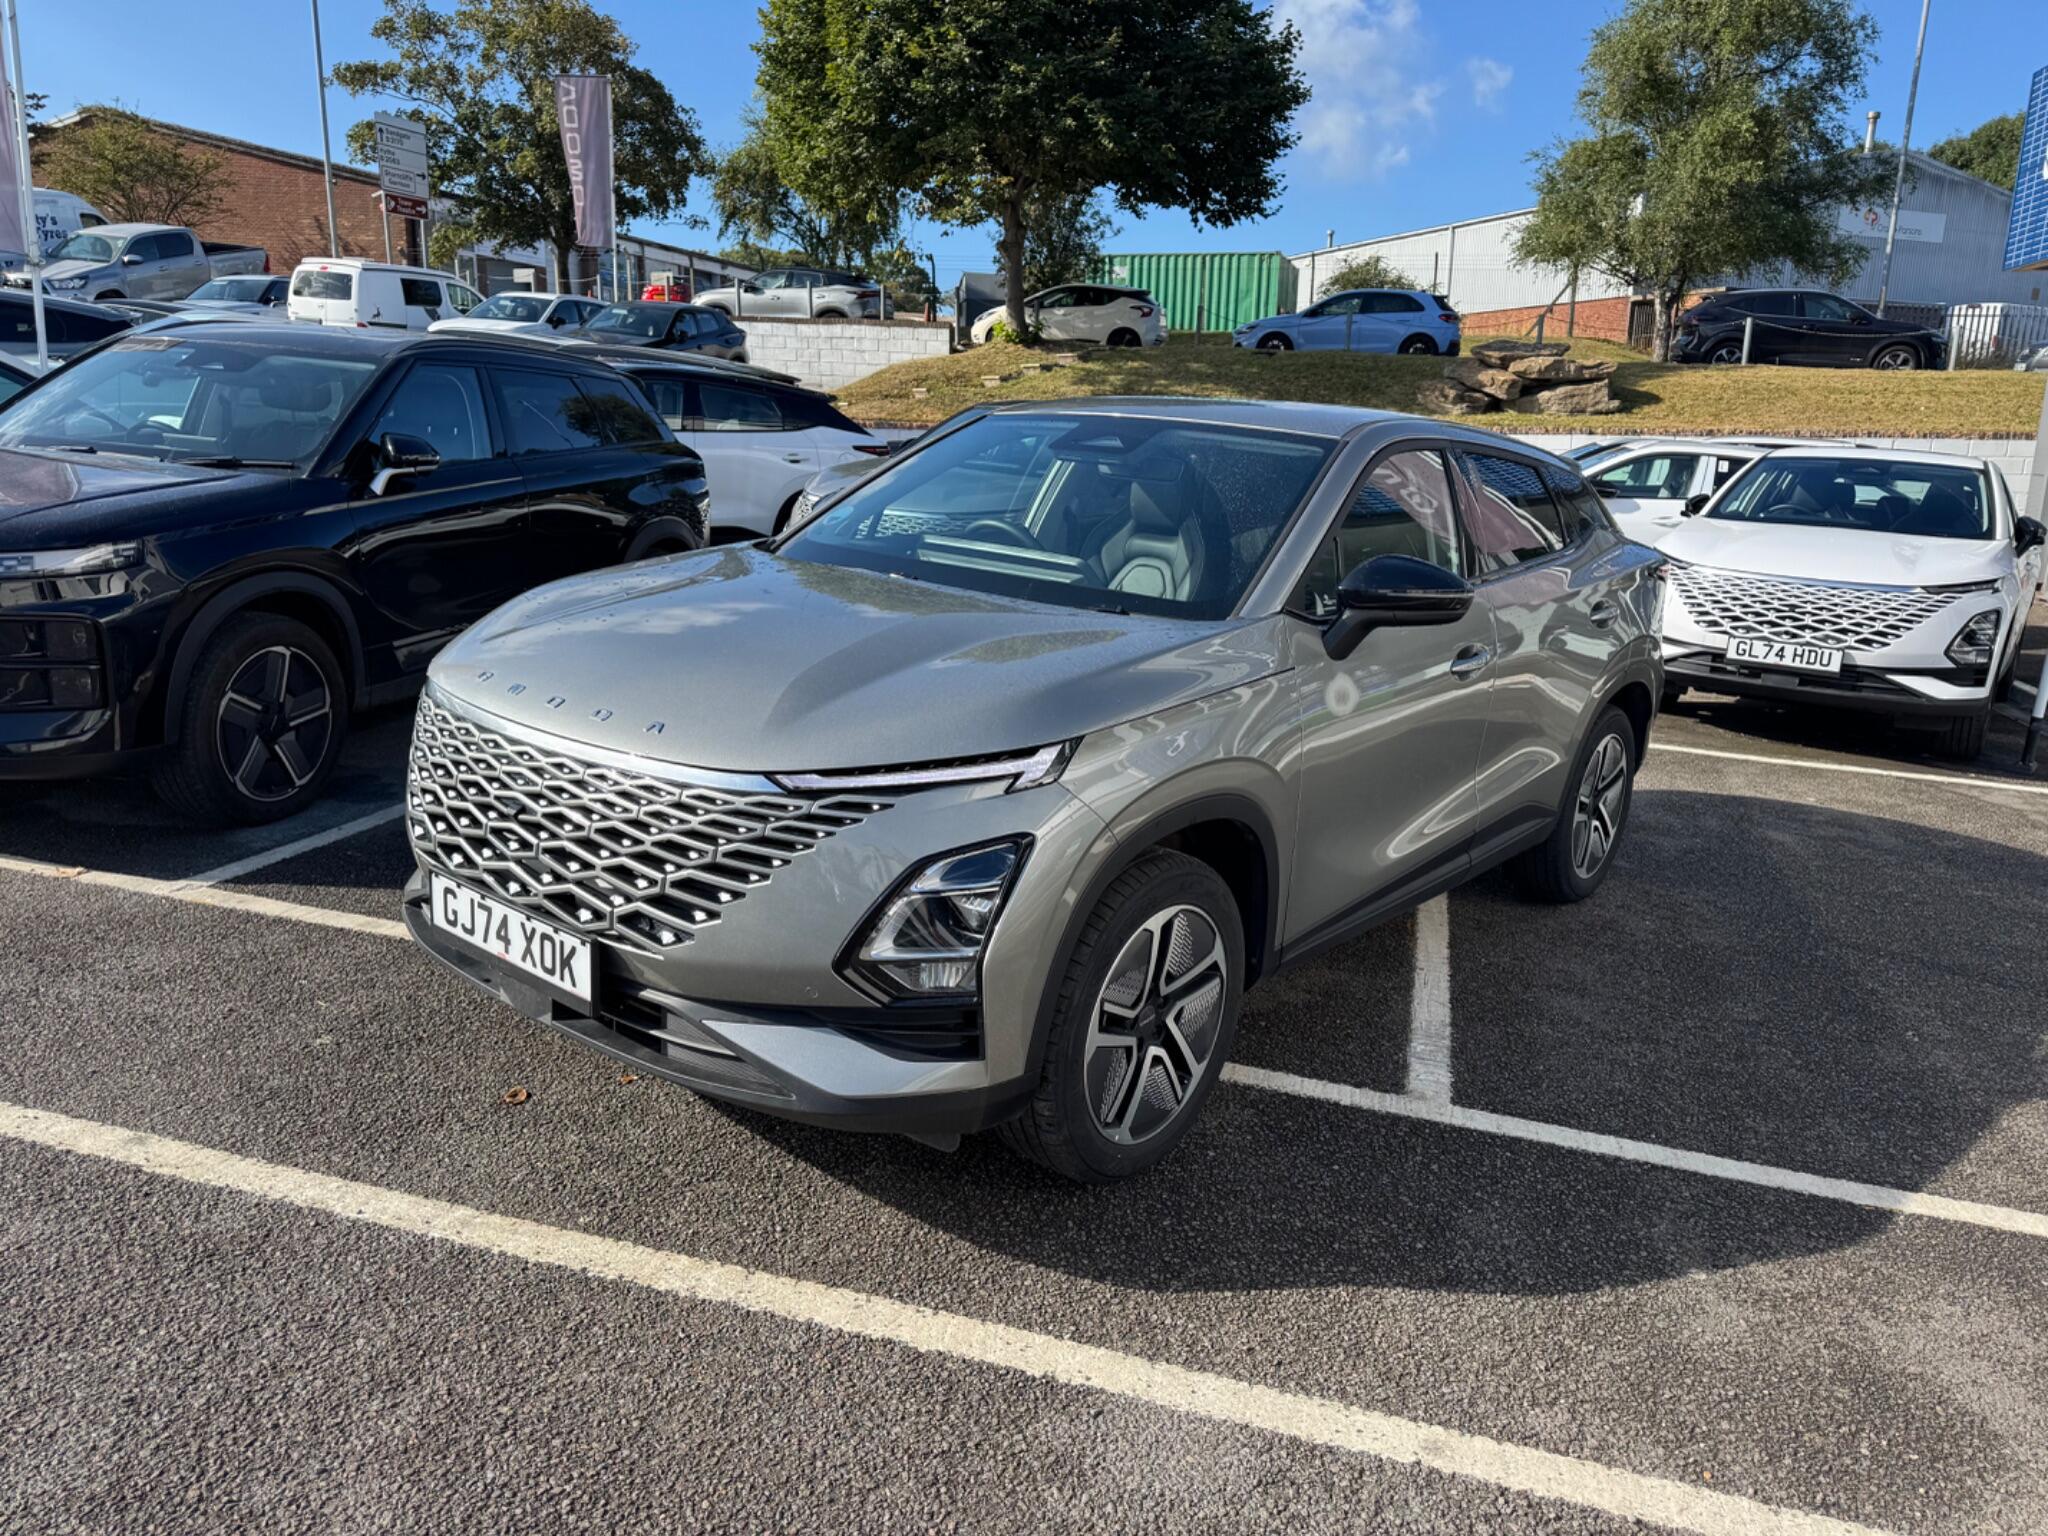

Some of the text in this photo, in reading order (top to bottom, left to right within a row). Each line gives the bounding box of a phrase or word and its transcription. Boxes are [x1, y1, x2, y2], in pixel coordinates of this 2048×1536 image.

[1735, 640, 1832, 668] GL74 HDU
[478, 671, 665, 735] OMODA
[443, 886, 577, 988] GJ74 XOK
